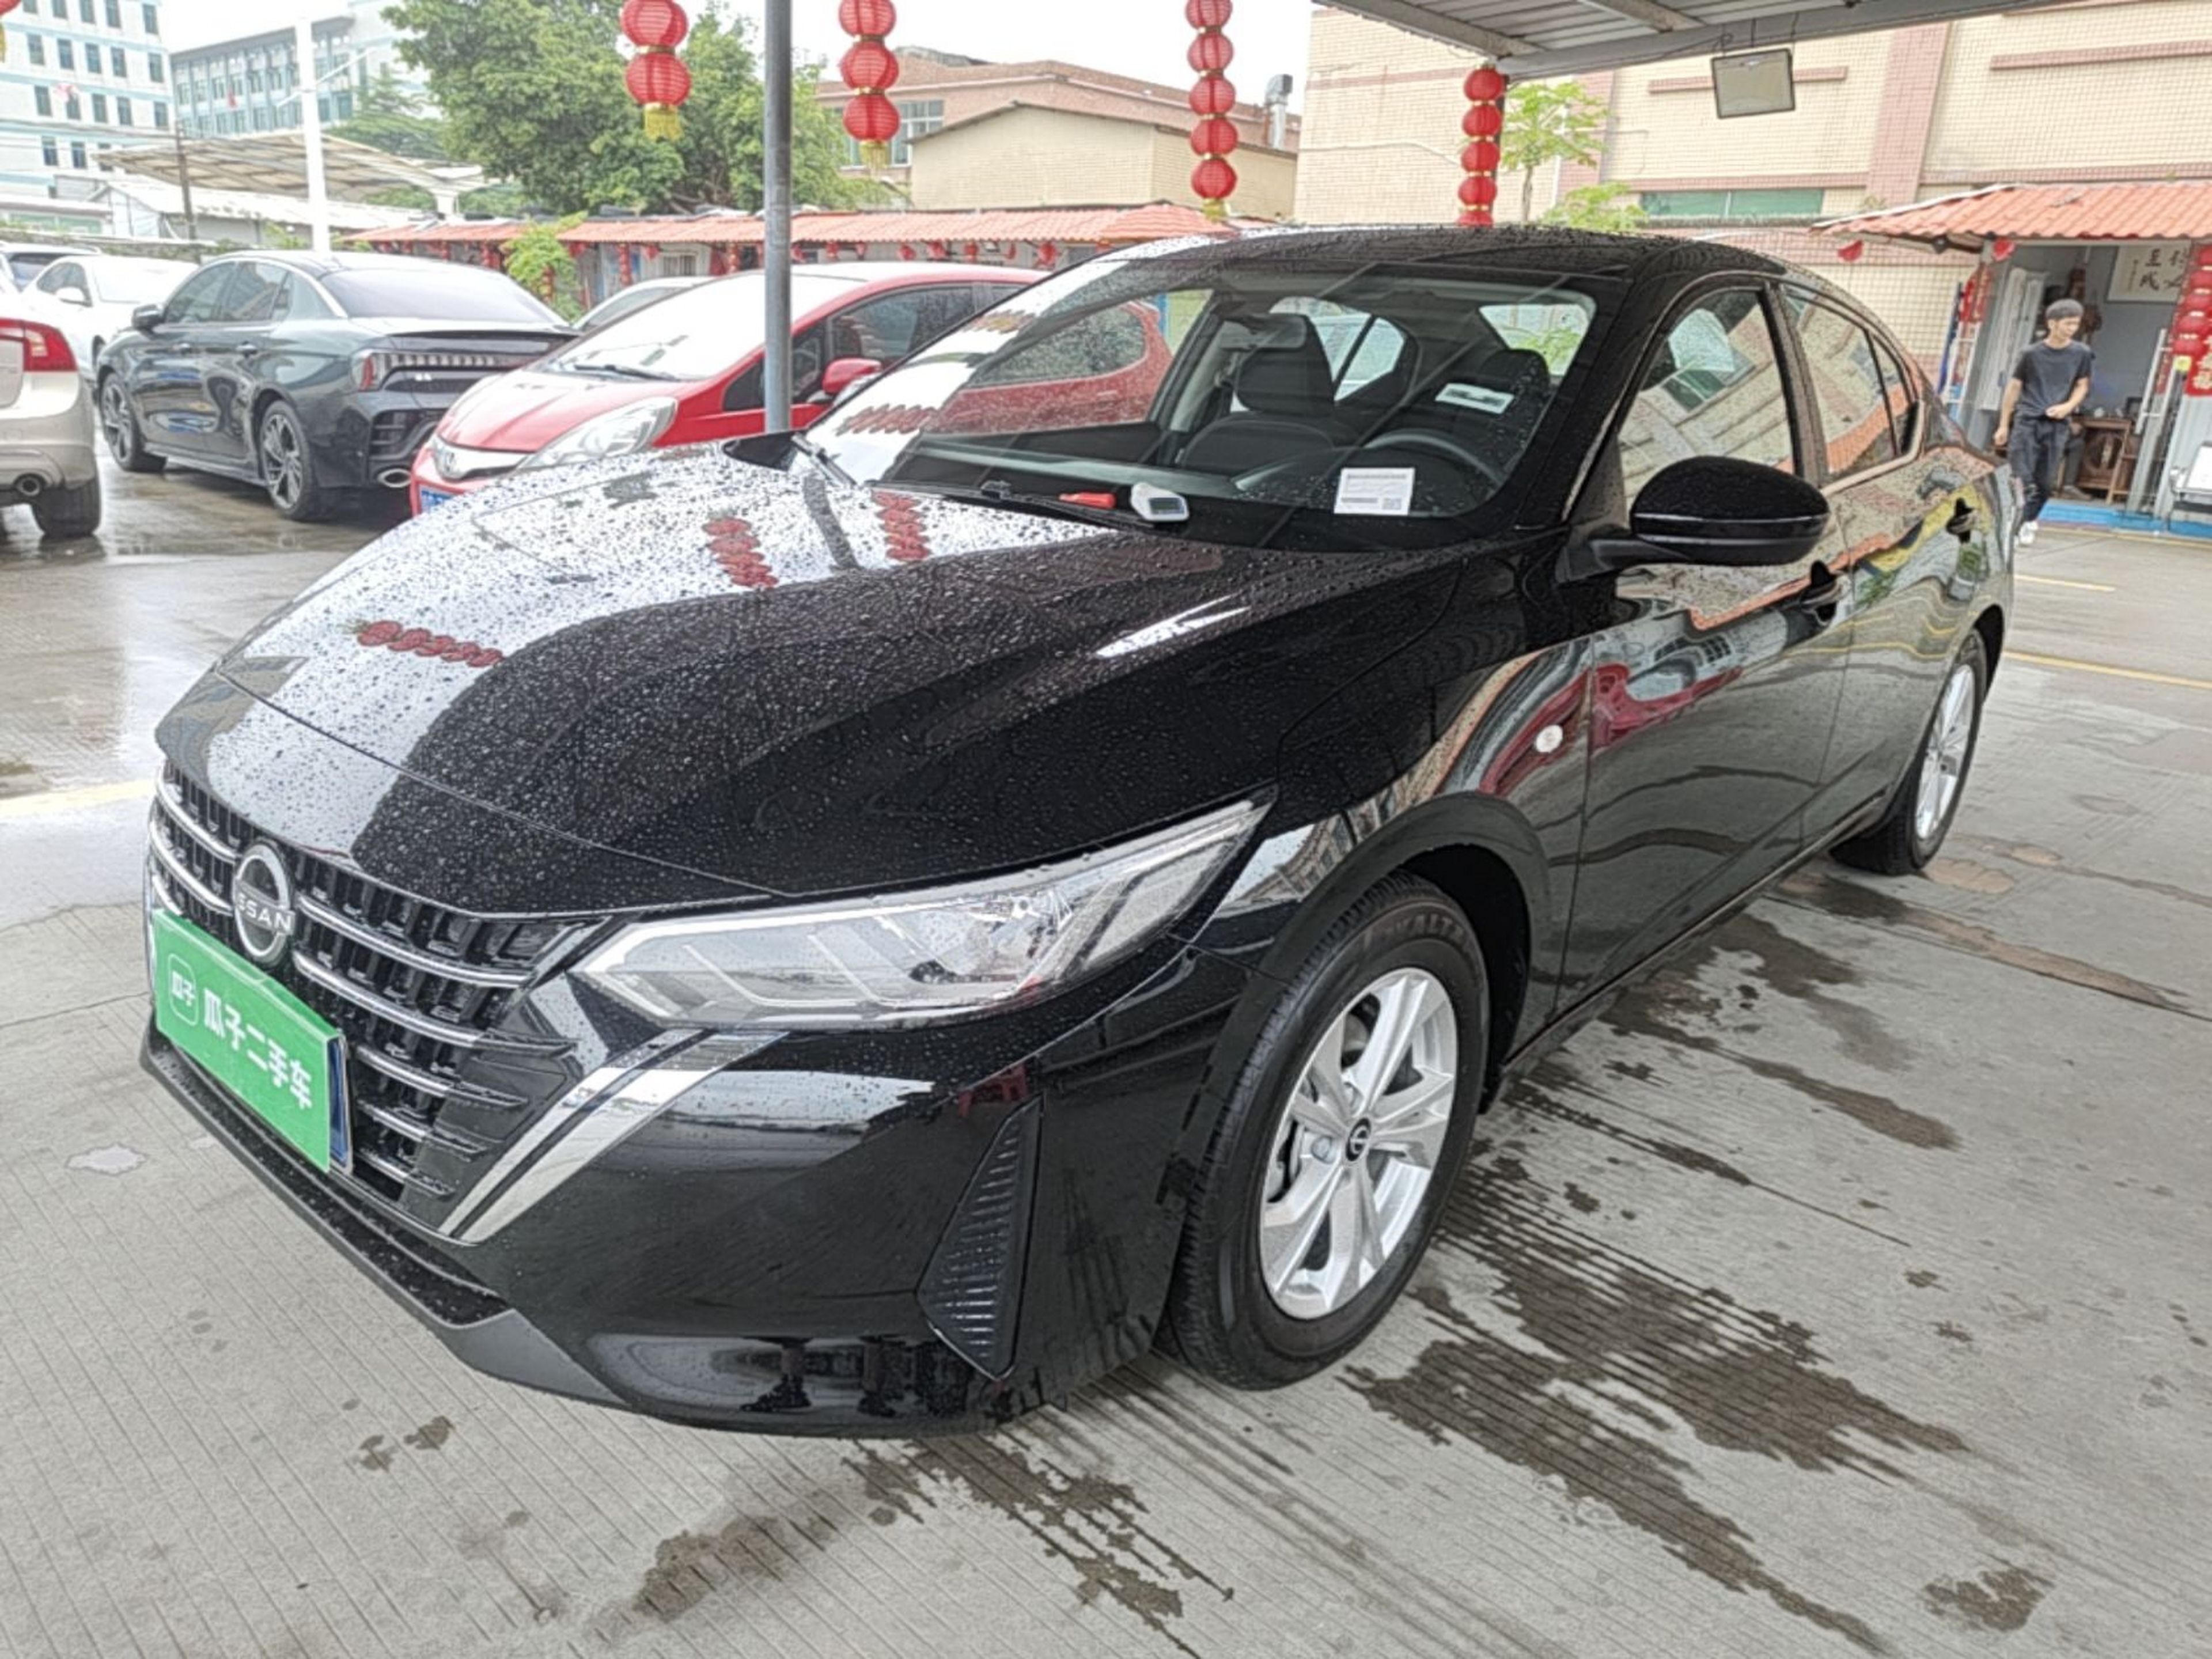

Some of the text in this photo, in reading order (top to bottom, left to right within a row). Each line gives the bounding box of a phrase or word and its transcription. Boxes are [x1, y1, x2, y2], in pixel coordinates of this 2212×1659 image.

[237, 891, 292, 932] SSAN
[203, 987, 312, 1110] 瓜子二手车
